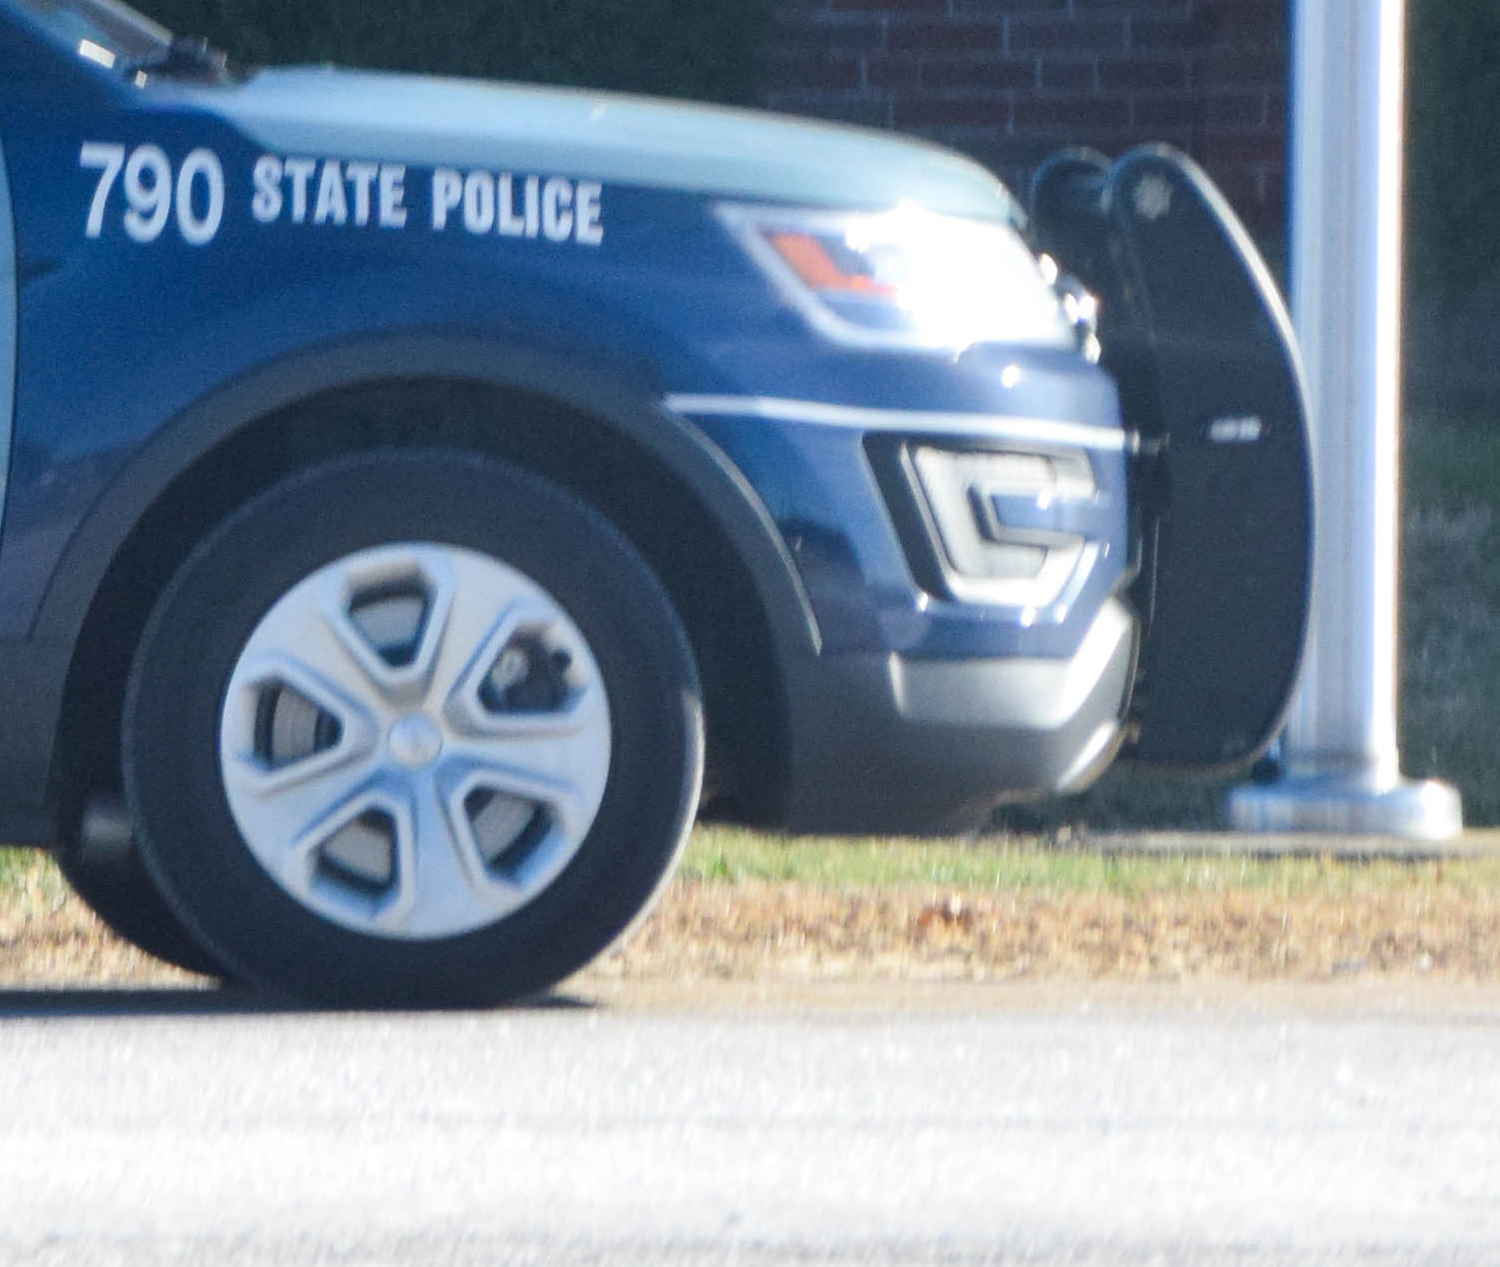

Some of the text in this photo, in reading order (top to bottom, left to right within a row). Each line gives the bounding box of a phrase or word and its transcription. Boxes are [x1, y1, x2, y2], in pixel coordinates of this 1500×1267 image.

[80, 141, 604, 246] 790 STATE POLICE
